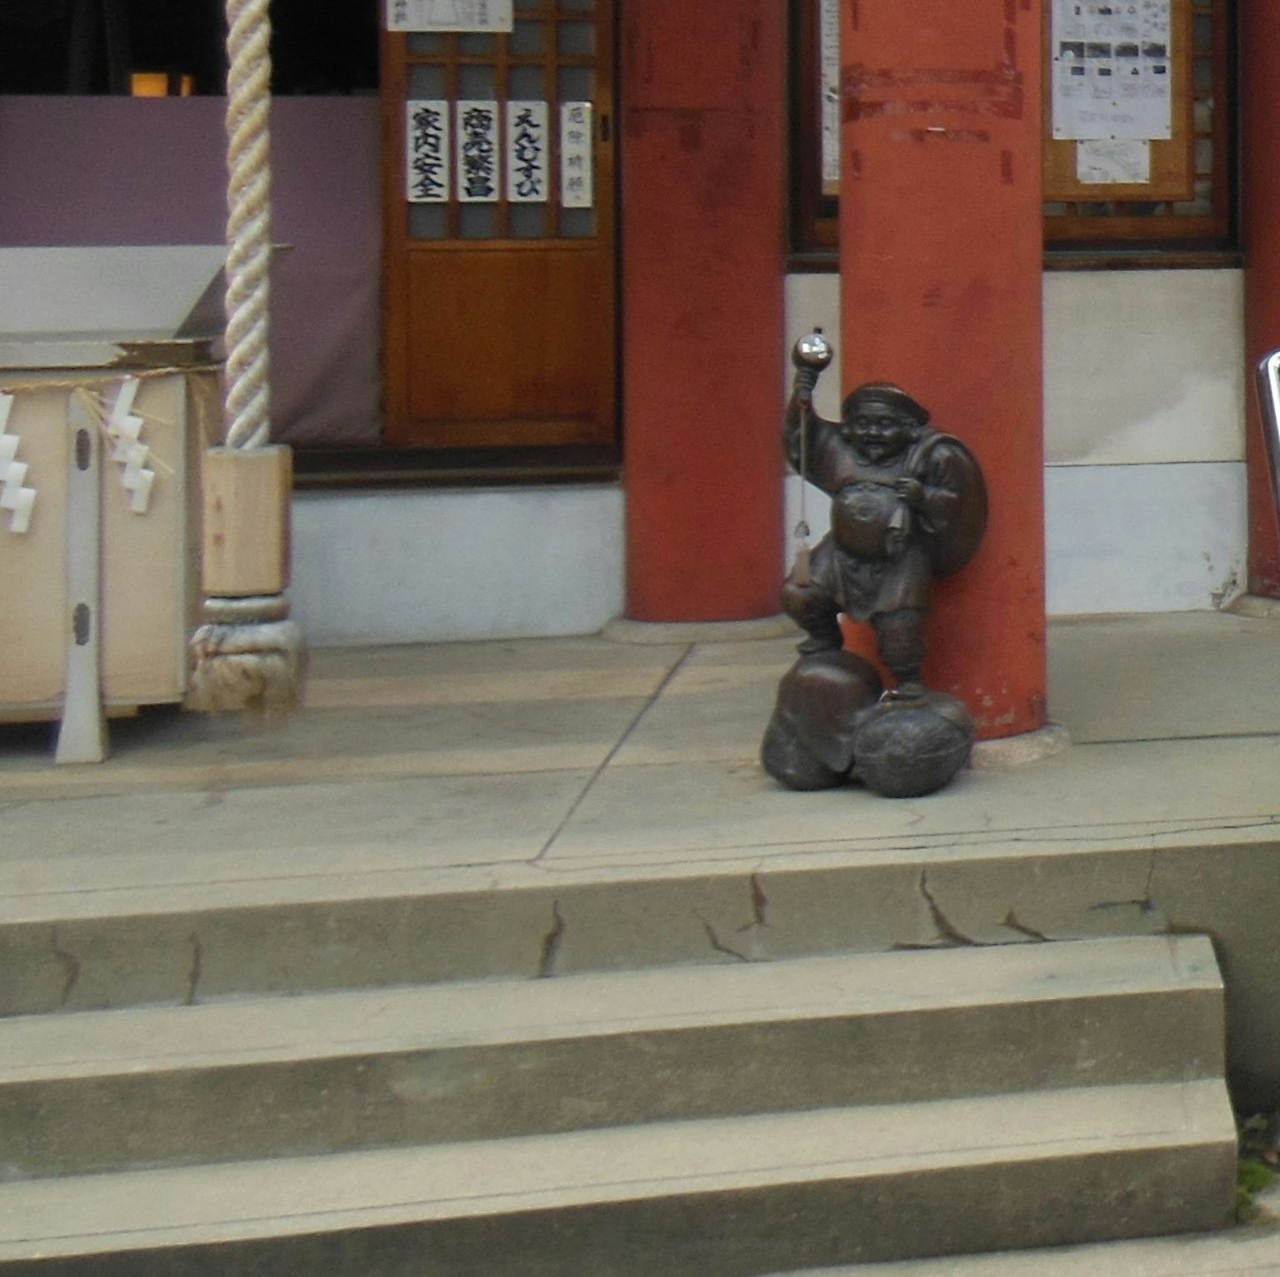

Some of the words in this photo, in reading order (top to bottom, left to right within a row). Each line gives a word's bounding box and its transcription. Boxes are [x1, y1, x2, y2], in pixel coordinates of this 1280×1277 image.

[412, 106, 444, 199] 家内安全
[462, 106, 494, 198] 商売繁昌
[514, 108, 541, 197] えんむすび
